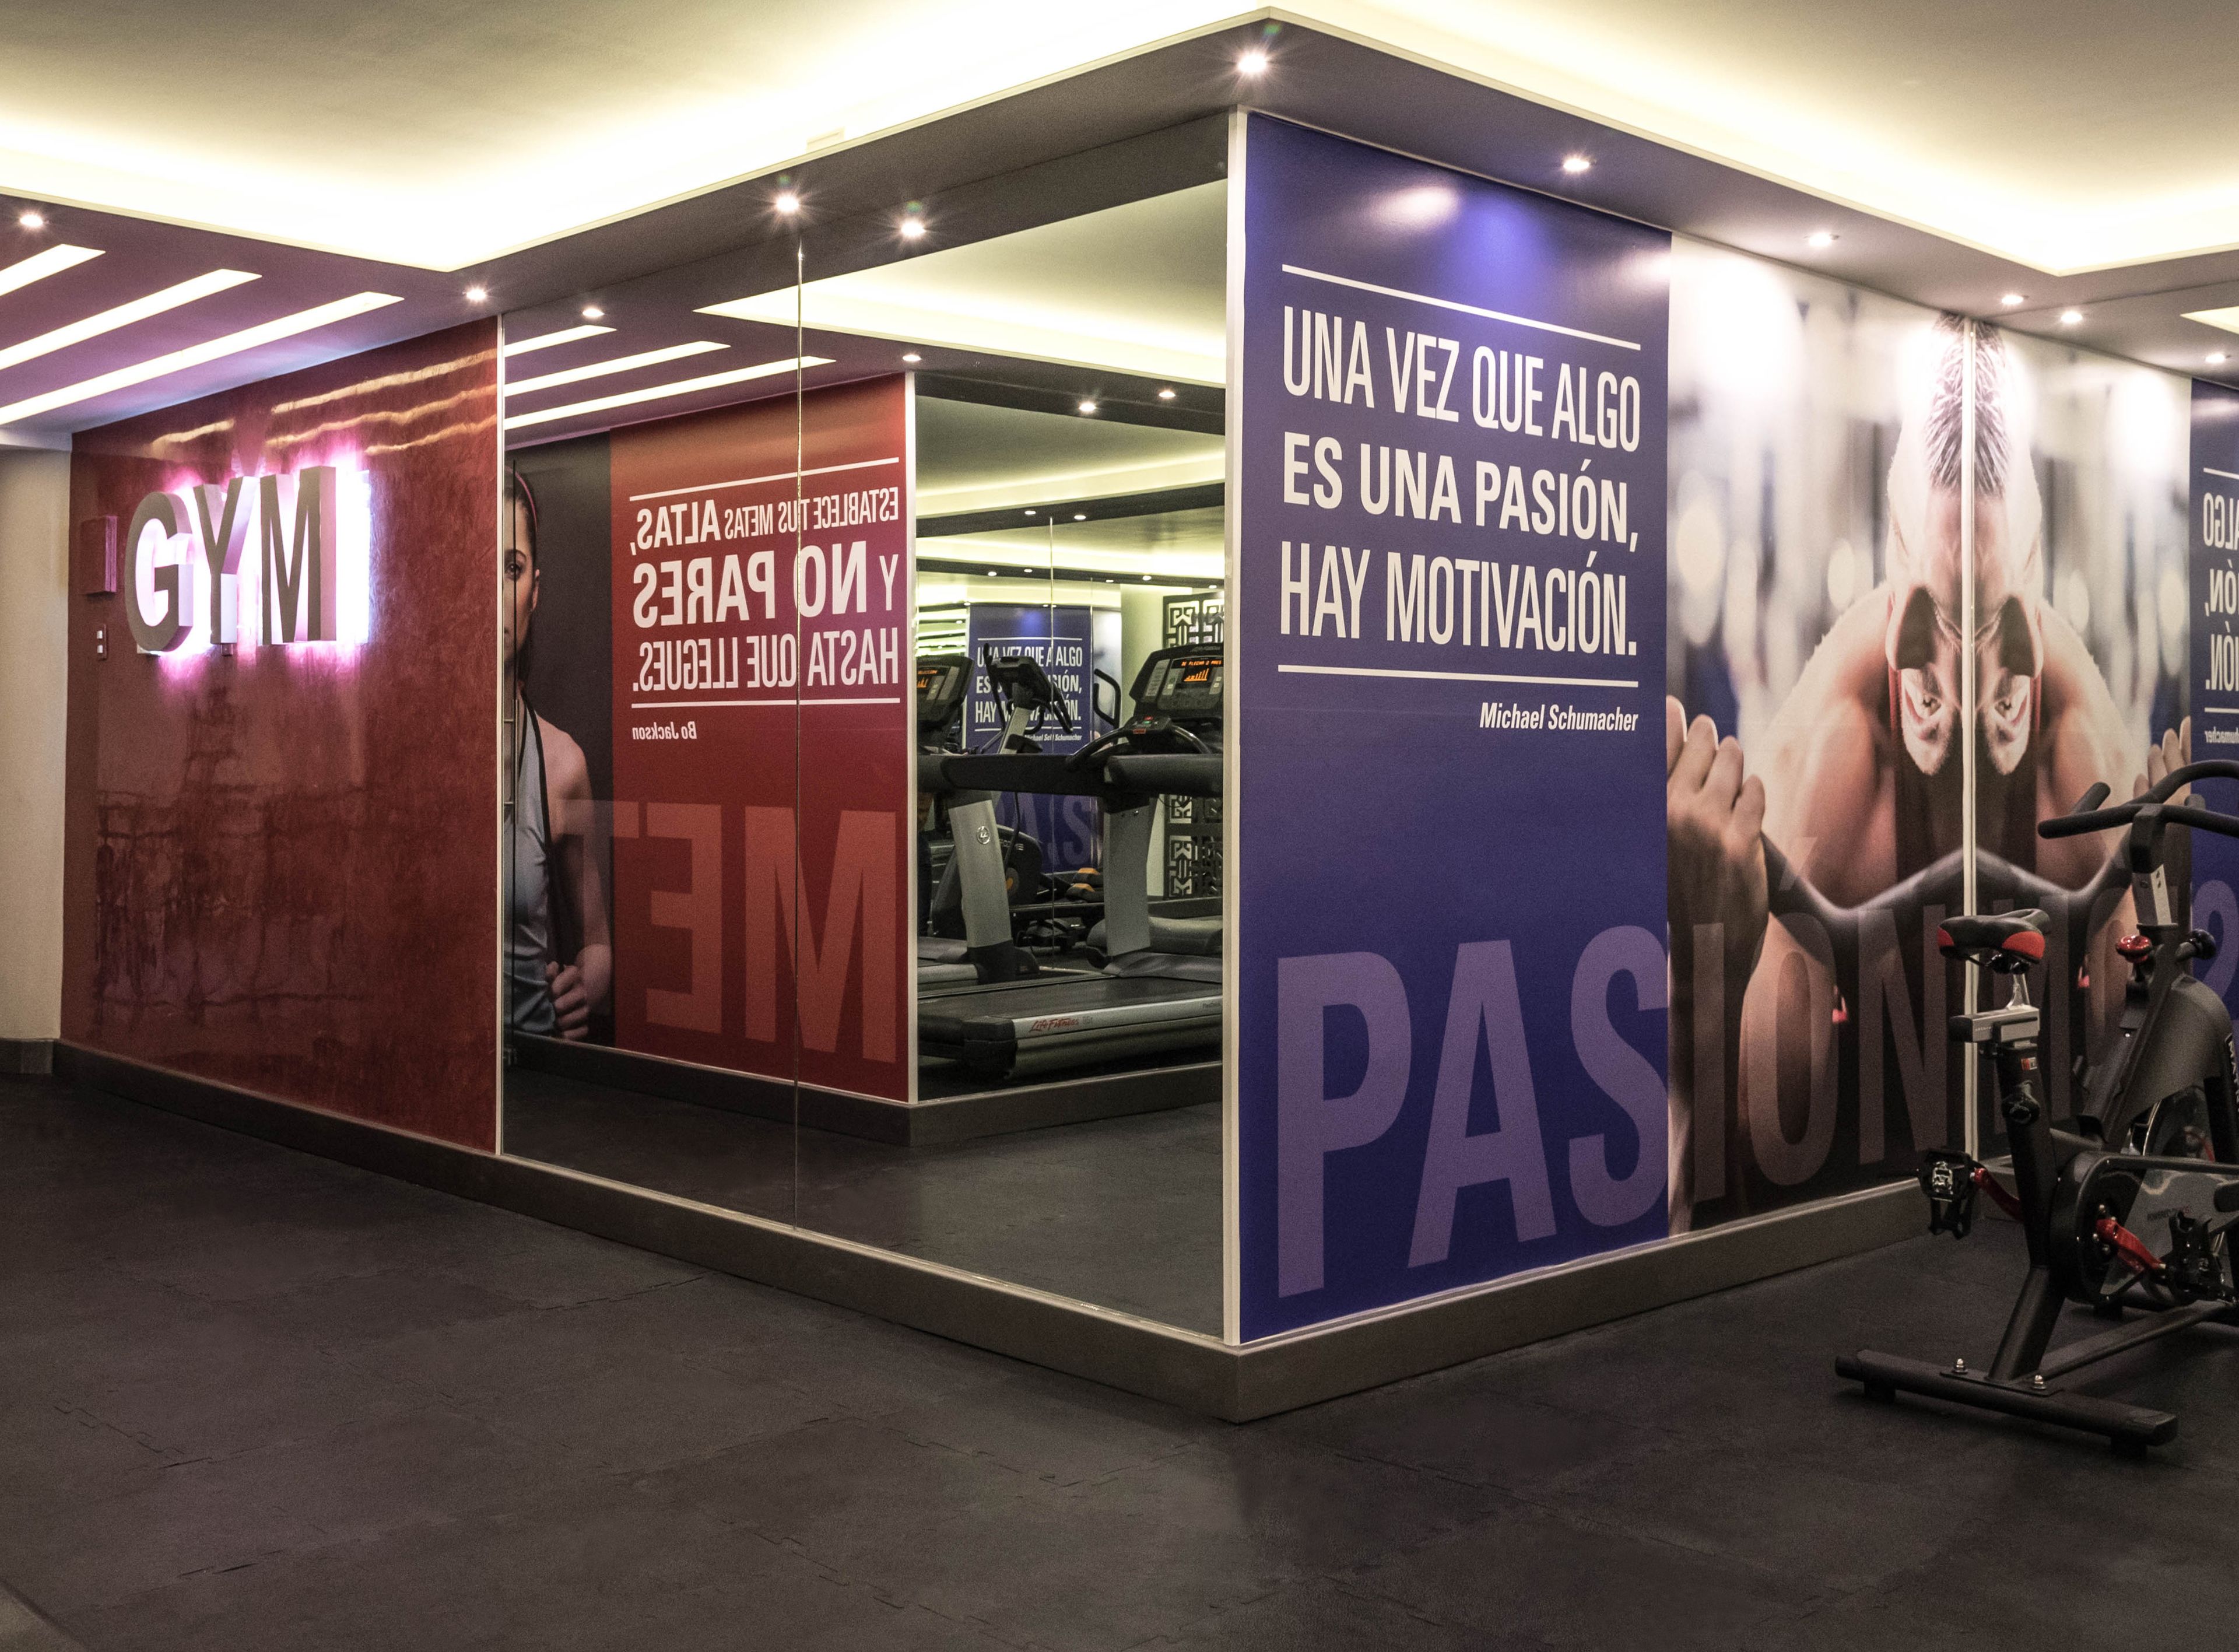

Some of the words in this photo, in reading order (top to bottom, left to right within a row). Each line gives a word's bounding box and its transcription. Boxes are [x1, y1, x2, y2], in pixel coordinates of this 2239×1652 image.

[1284, 306, 1374, 408] UNA
[1386, 327, 1459, 422] VEZ
[1472, 346, 1543, 437] QUE
[1552, 363, 1640, 452] ALGO
[1284, 432, 1342, 508] ES
[1360, 444, 1461, 524] UNA
[1476, 459, 1638, 552] PASIÓN,
[125, 467, 336, 652] GYM
[1281, 541, 1370, 639] HAY
[1387, 551, 1637, 655] MOTIVACIÓN.
[976, 675, 991, 693] ES
[1056, 646, 1083, 667] ALGO
[975, 701, 997, 722] HAY
[1480, 702, 1544, 730] Michael
[1548, 704, 1638, 732] Schumacher
